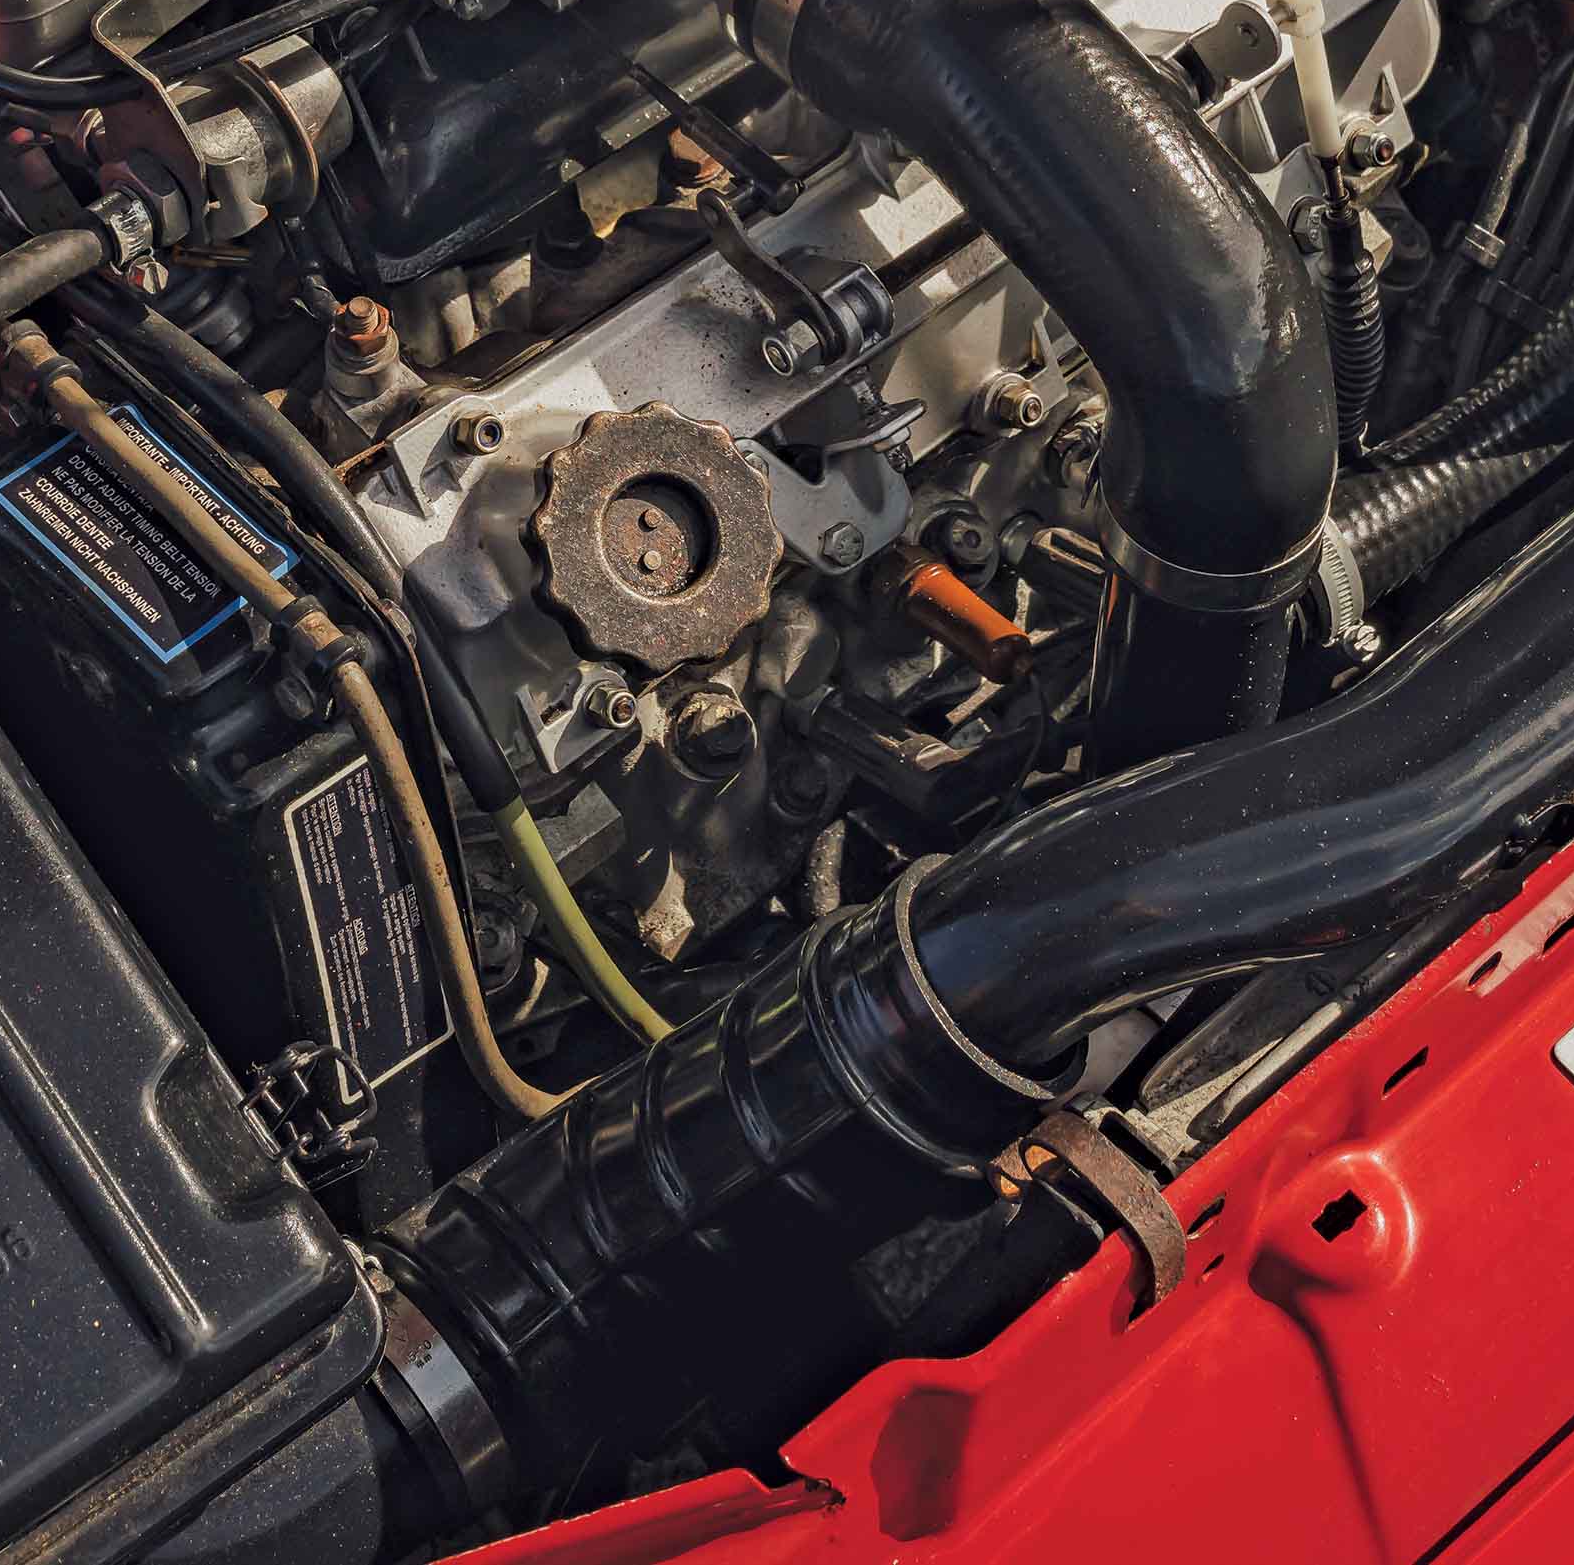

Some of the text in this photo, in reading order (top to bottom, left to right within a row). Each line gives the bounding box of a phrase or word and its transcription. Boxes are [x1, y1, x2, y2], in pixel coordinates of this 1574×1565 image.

[35, 477, 82, 520] COURRDIE
[75, 516, 114, 551] DENTEE
[51, 466, 198, 604] NE PAS MODIFIER LA TENSION DE LA
[68, 454, 222, 597] DO NOT ADJUST TIMING BELT TENSION
[116, 417, 169, 468] IMPORTANTE
[169, 467, 220, 517] IMPORTANT
[219, 513, 266, 555] ACHTUNG
[18, 487, 162, 624] ZAHNRIEMEN NICHT NACHSPANNEN
[326, 792, 343, 837] ATTENTION
[353, 917, 369, 956] ACHTUNG
[404, 883, 422, 929] ATTENTION
